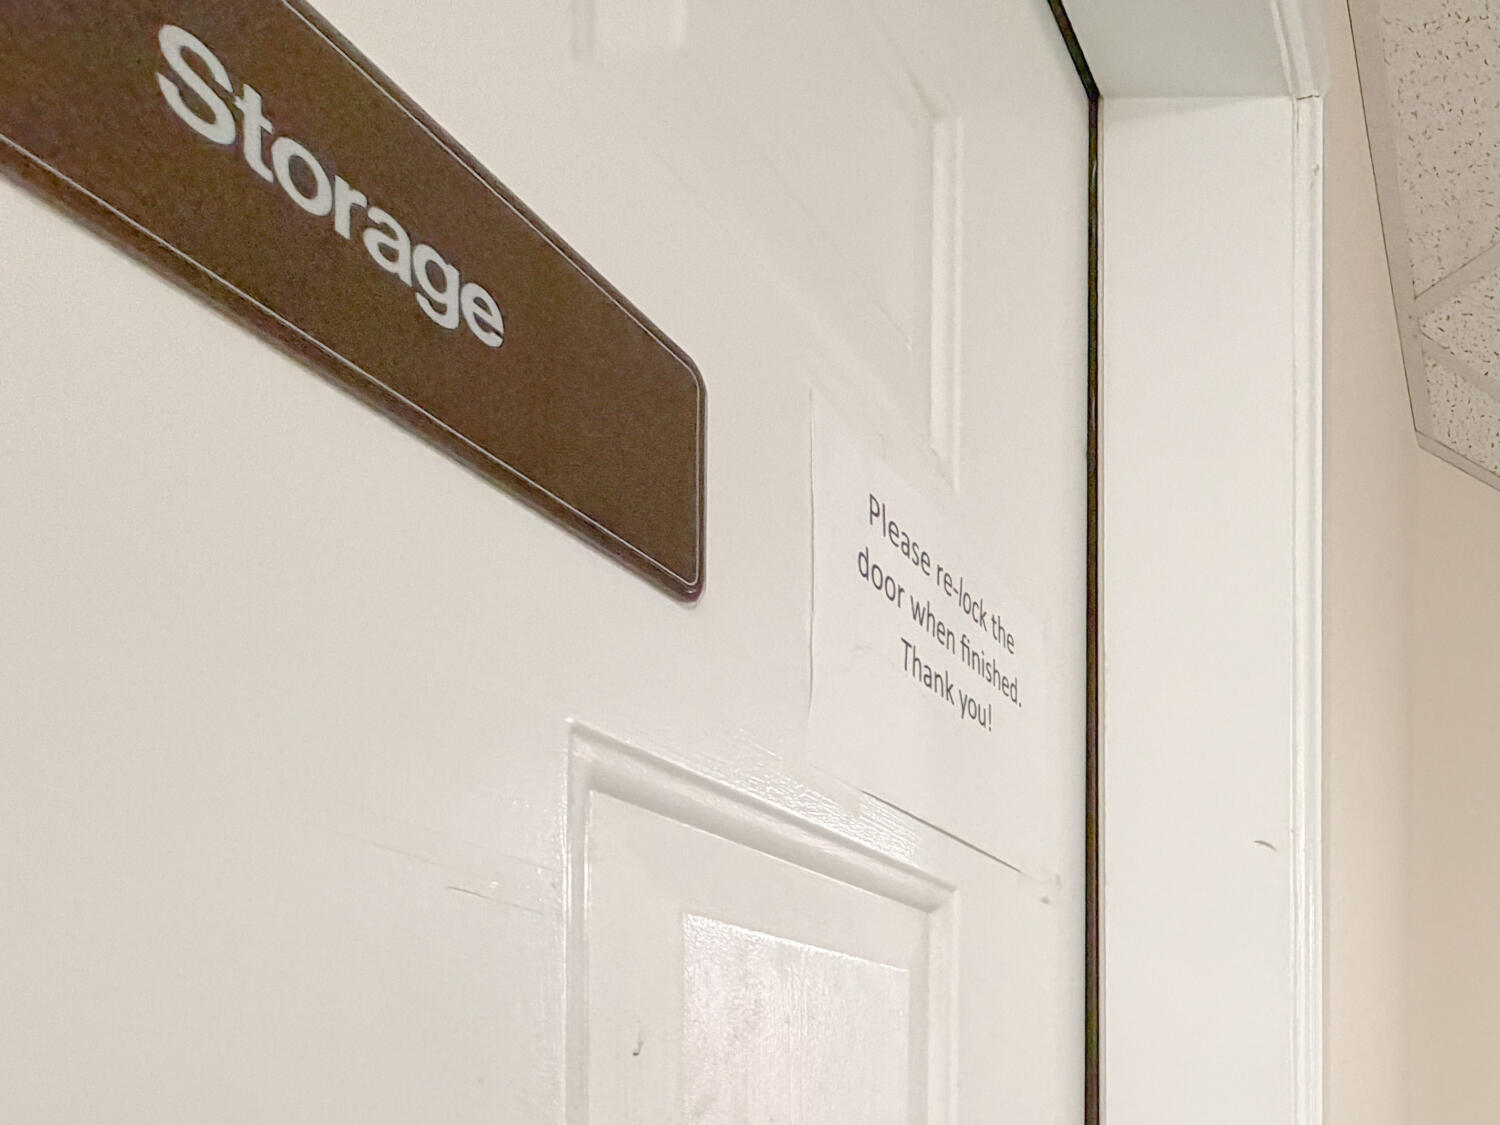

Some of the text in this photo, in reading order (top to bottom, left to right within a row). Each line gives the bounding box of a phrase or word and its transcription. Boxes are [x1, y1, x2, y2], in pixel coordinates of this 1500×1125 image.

[156, 24, 504, 347] Storage
[857, 547, 1022, 707] door when finished.
[869, 494, 1015, 655] Please re-lock the
[901, 638, 992, 731] Thank you!
